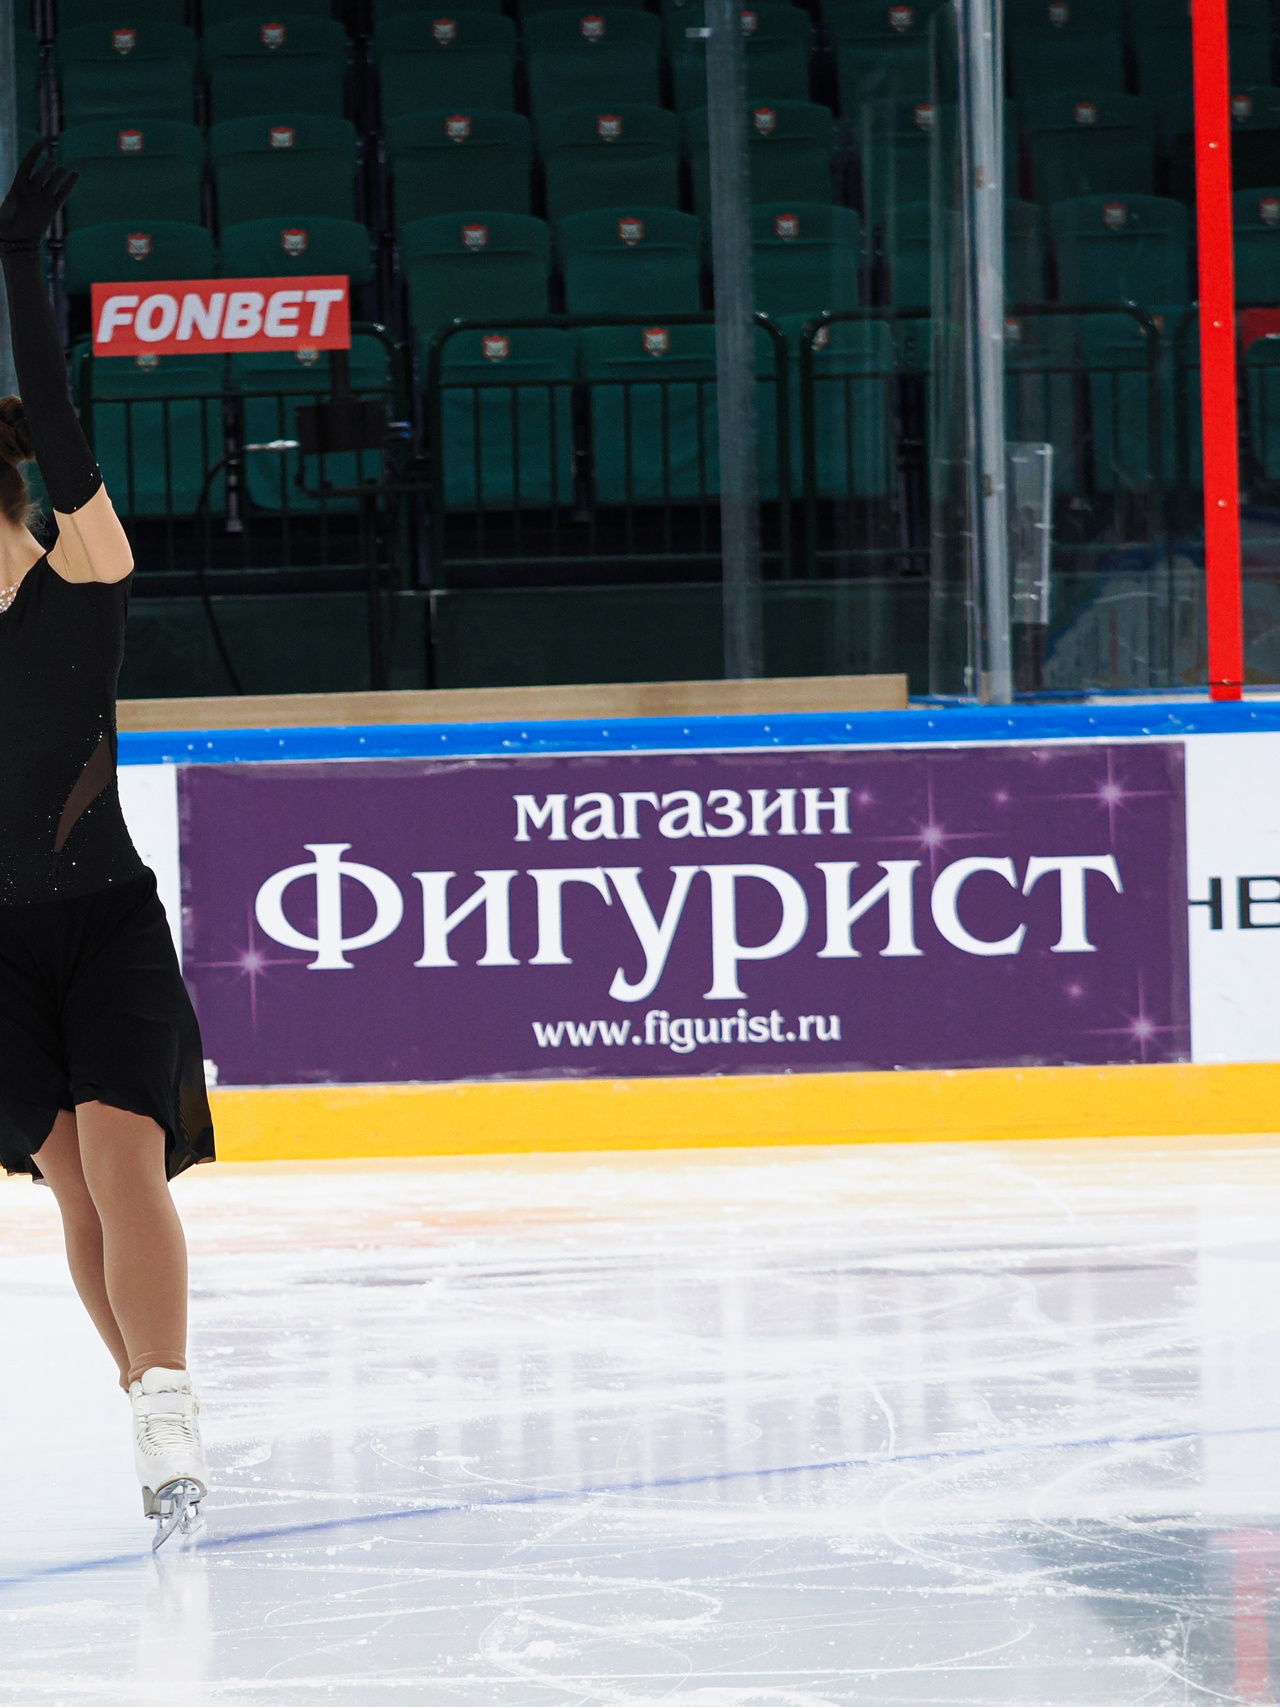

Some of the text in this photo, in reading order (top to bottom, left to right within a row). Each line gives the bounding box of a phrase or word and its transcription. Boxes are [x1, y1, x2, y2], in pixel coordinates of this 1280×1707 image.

[97, 289, 345, 342] FONBET
[513, 787, 851, 841] магазин
[532, 1008, 841, 1053] www.figurist.ru
